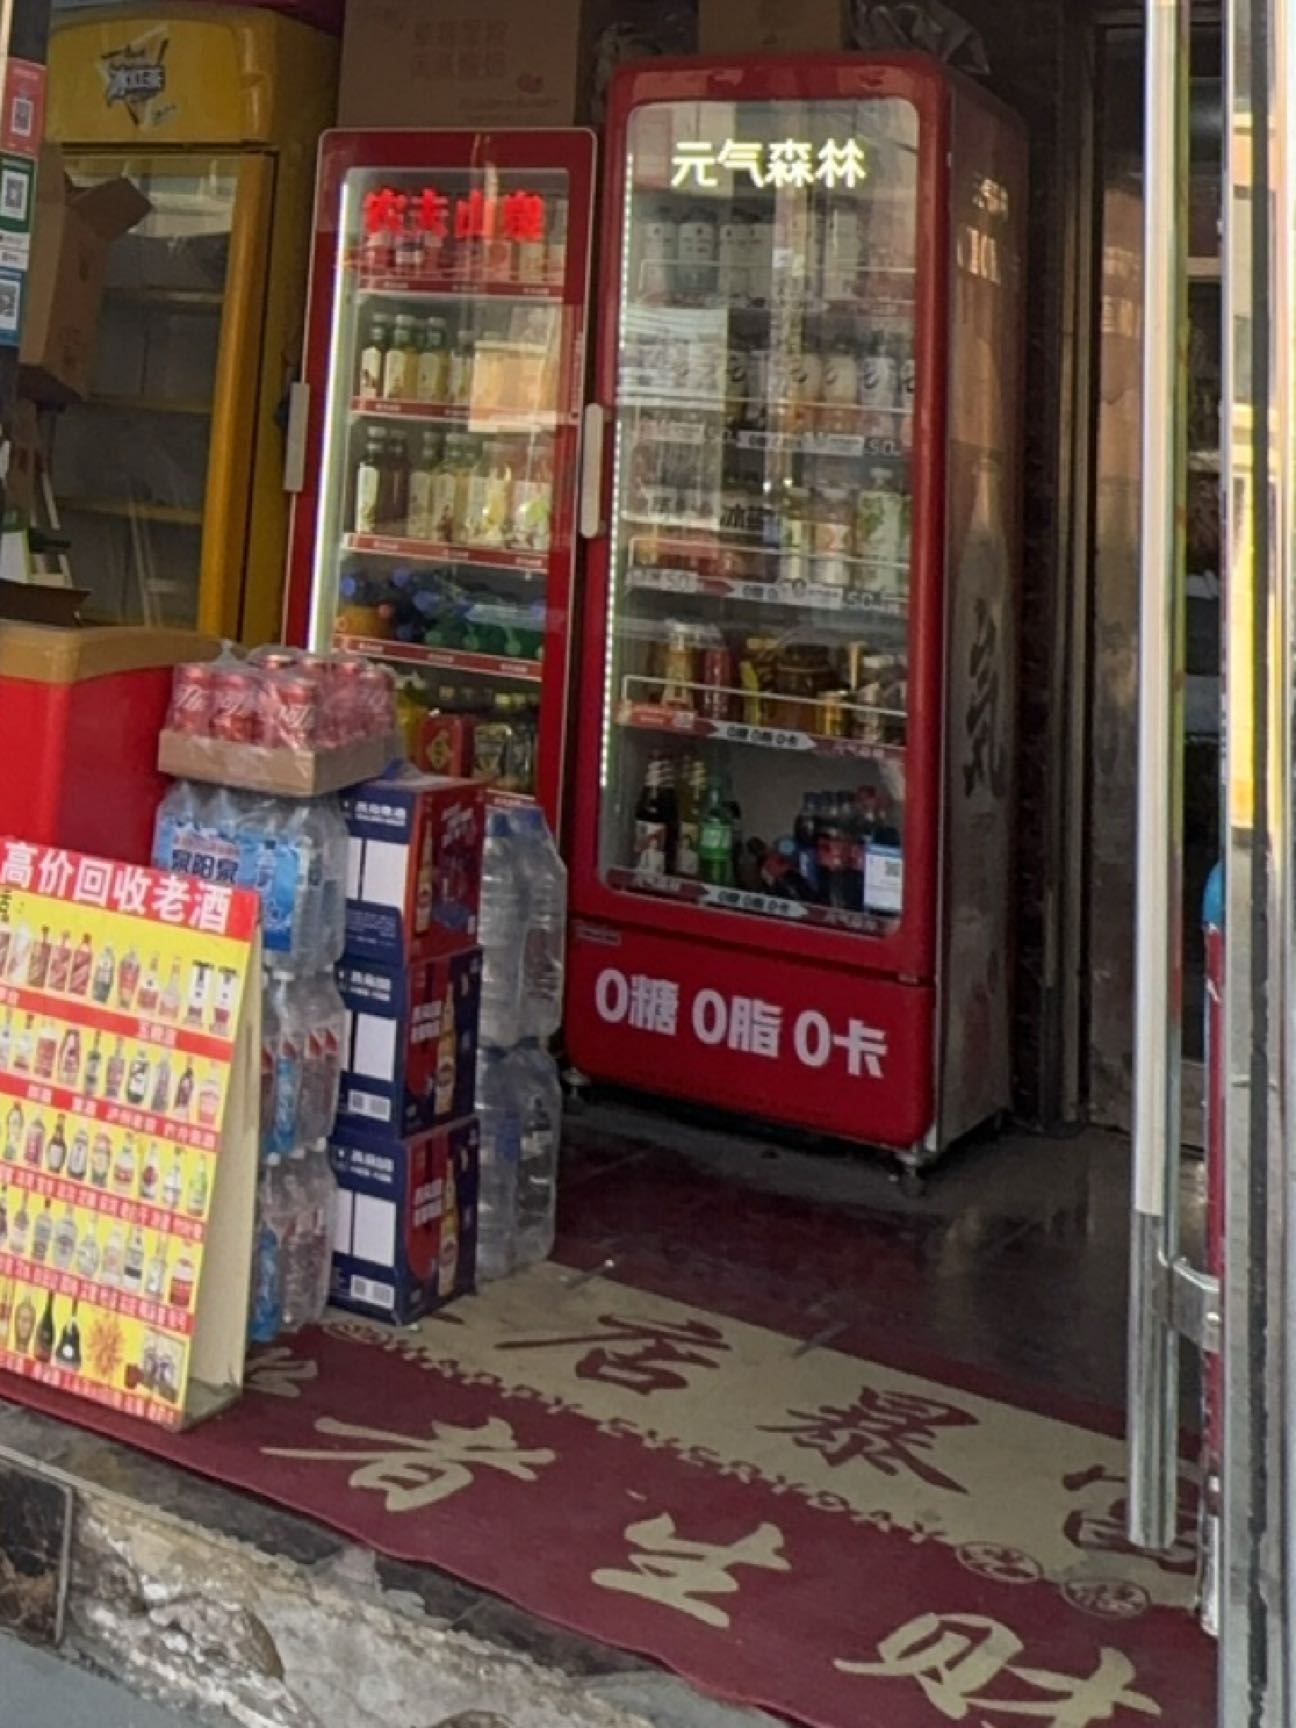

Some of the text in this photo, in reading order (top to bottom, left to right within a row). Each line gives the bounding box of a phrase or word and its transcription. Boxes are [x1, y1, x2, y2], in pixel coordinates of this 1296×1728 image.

[671, 138, 867, 189] 元气森林
[0, 841, 232, 934] 高价回收老酒
[594, 969, 887, 1079] 0糖 0脂 0卡
